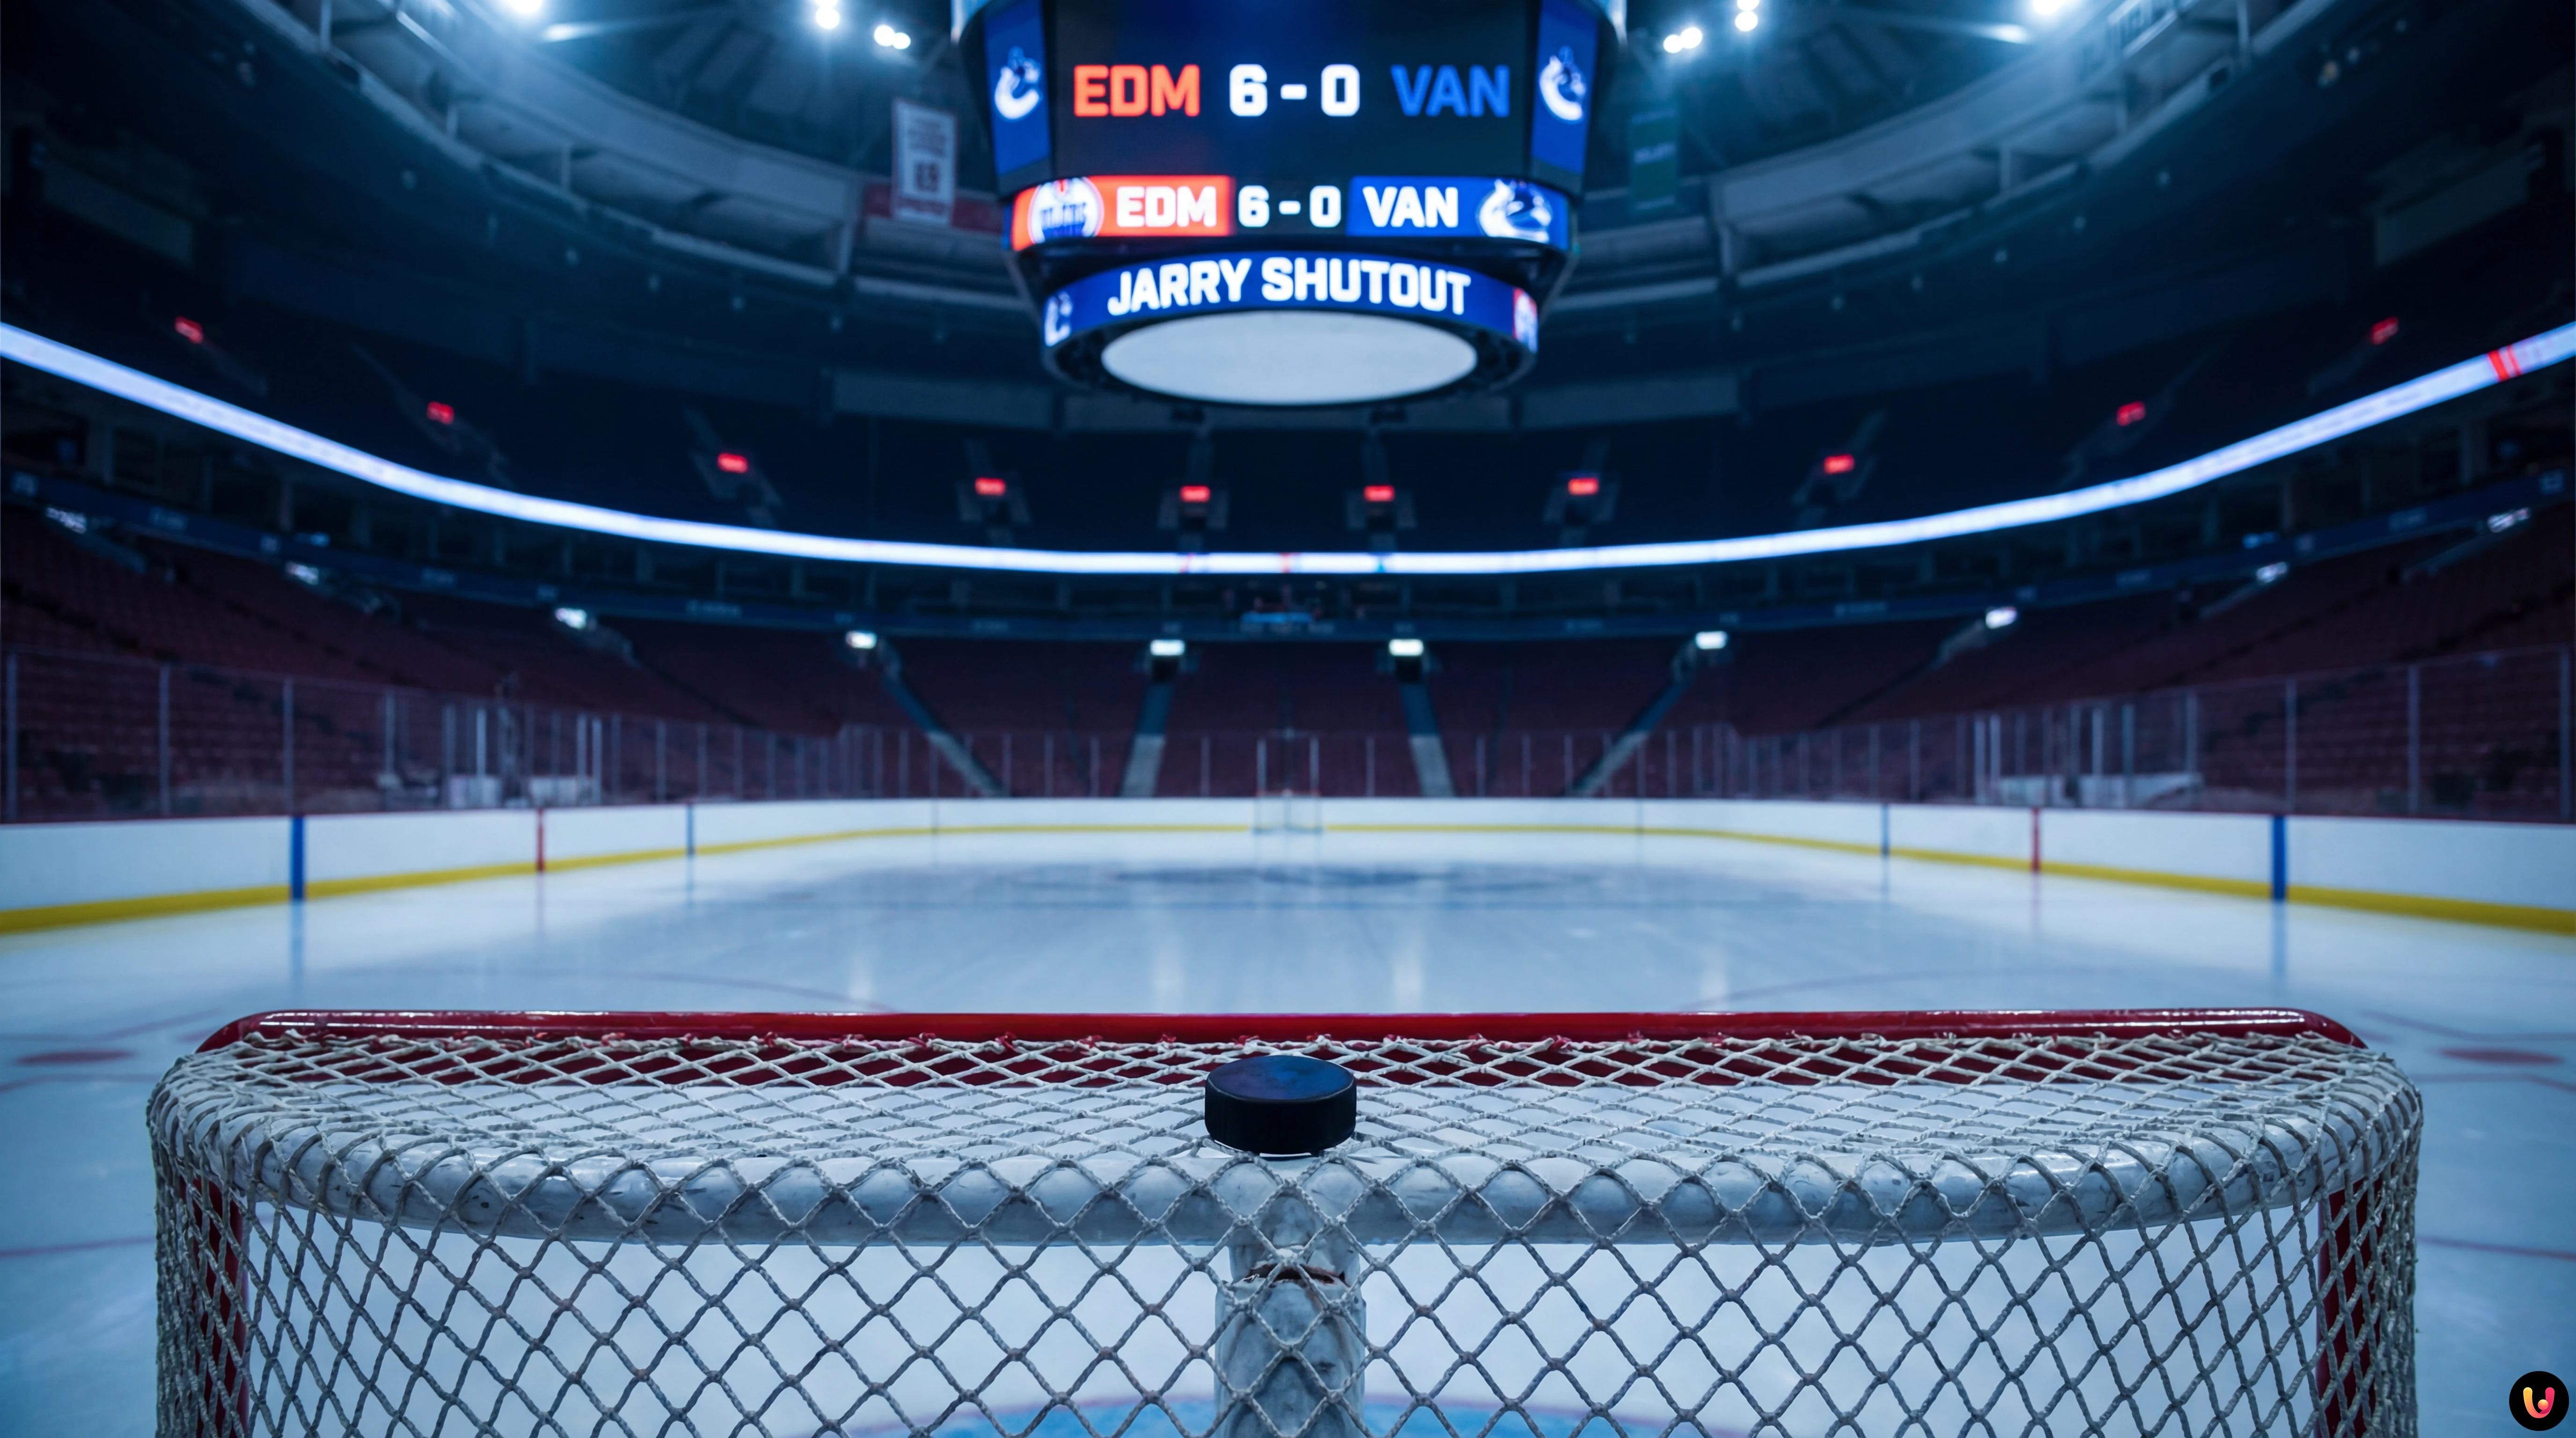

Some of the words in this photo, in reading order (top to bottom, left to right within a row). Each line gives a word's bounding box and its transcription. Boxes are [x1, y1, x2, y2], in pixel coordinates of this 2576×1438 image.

[1073, 64, 1200, 117] EDM
[1390, 64, 1510, 117] VAN
[1115, 185, 1218, 228] EDM
[1362, 186, 1459, 228] VAN
[1107, 258, 1252, 315] JARRY
[1261, 257, 1471, 315] SHUTOUT
